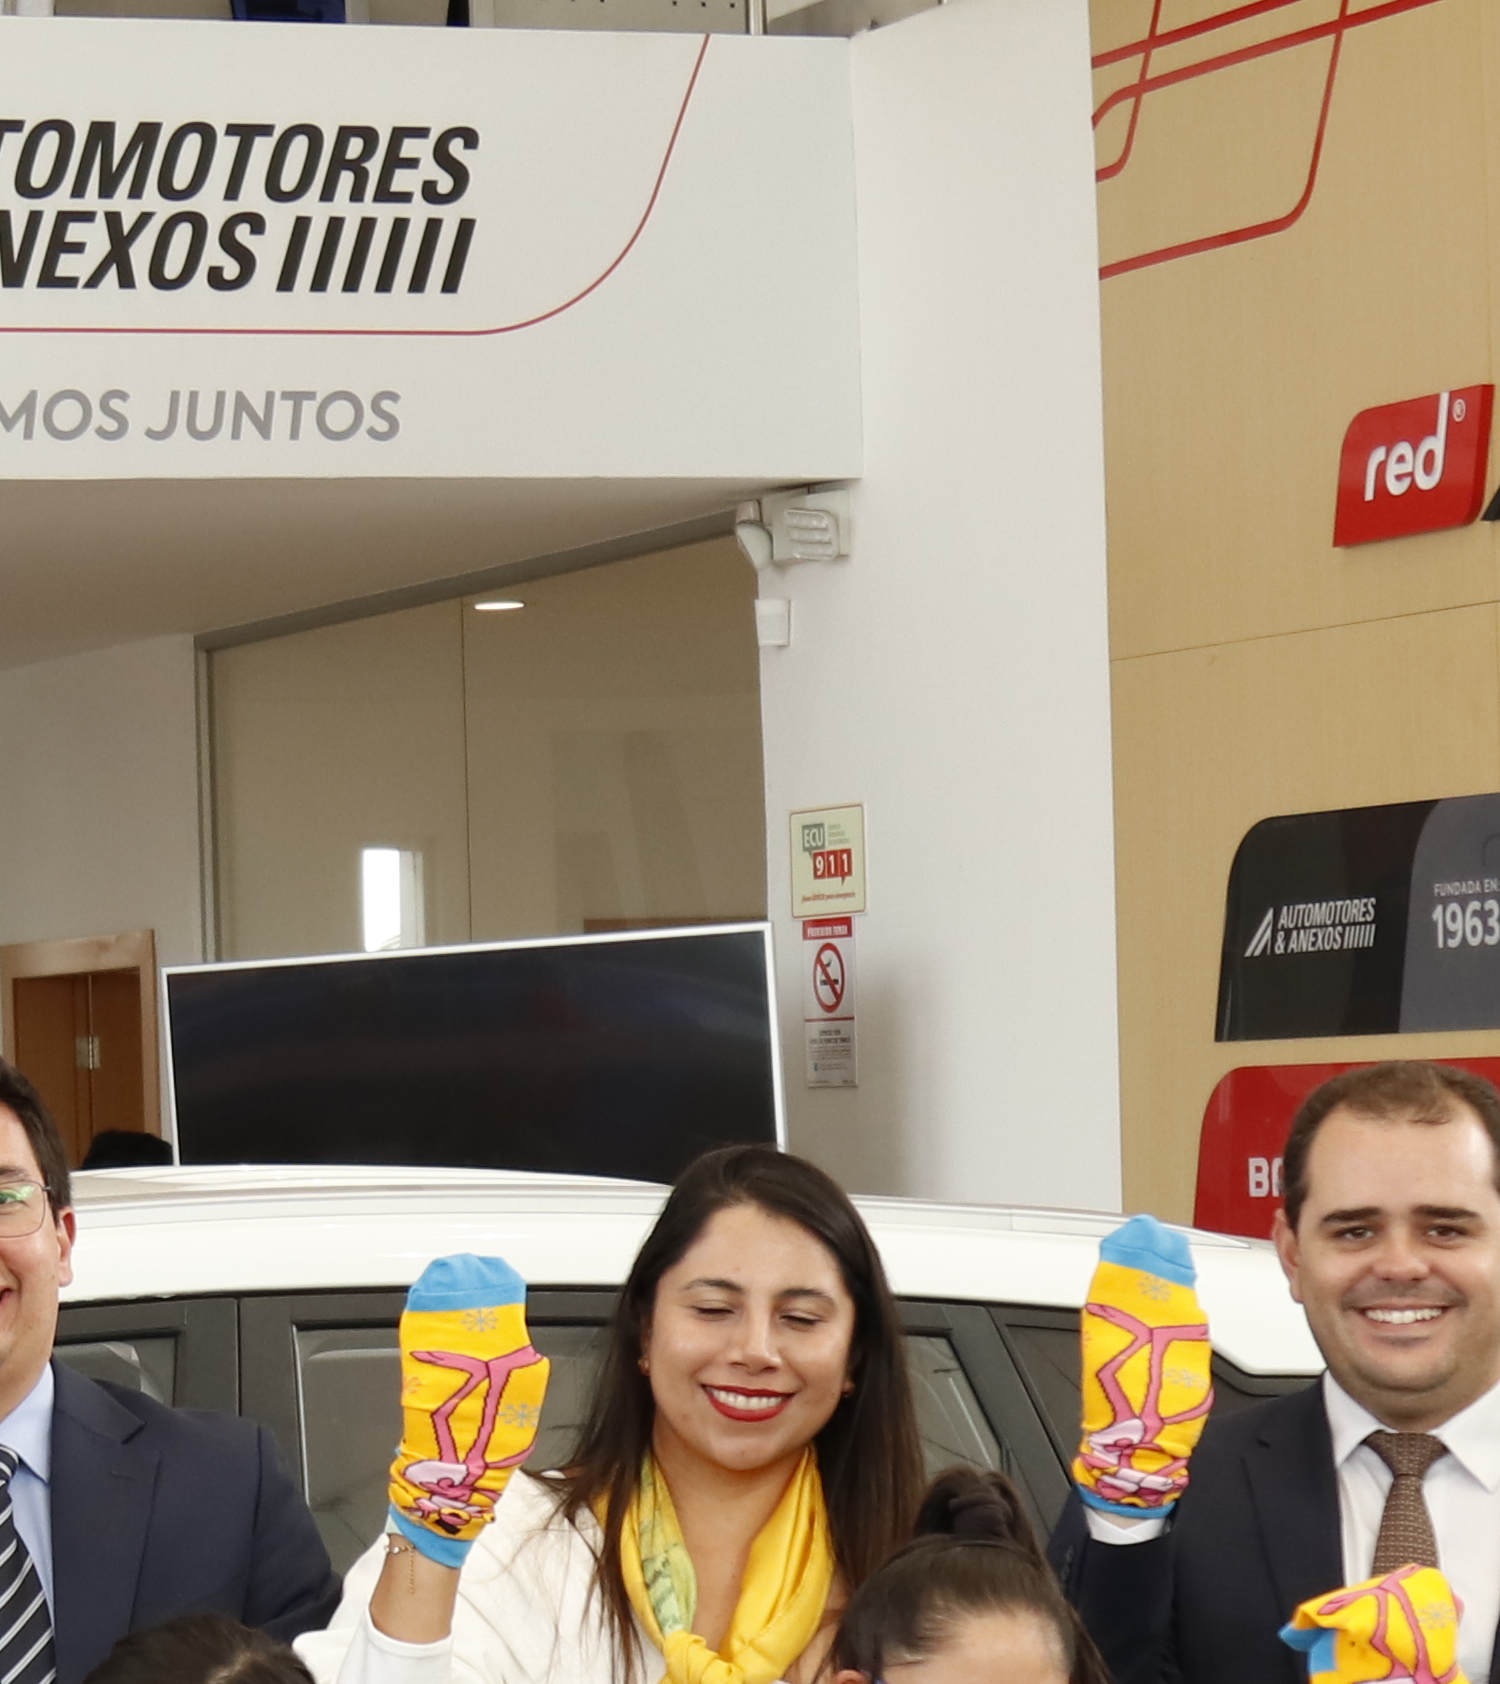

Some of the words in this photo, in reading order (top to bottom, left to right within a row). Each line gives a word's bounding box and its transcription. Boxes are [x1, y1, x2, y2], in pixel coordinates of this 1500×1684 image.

[143, 389, 402, 442] JUNTOS
[803, 827, 824, 848] ECU
[815, 853, 848, 876] 911
[1434, 880, 1481, 897] FUNDADA
[1277, 897, 1377, 929] AUTOMOTORES
[1432, 899, 1500, 949] 1963
[1274, 930, 1285, 954] &
[1287, 926, 1343, 953] ANEXOS
